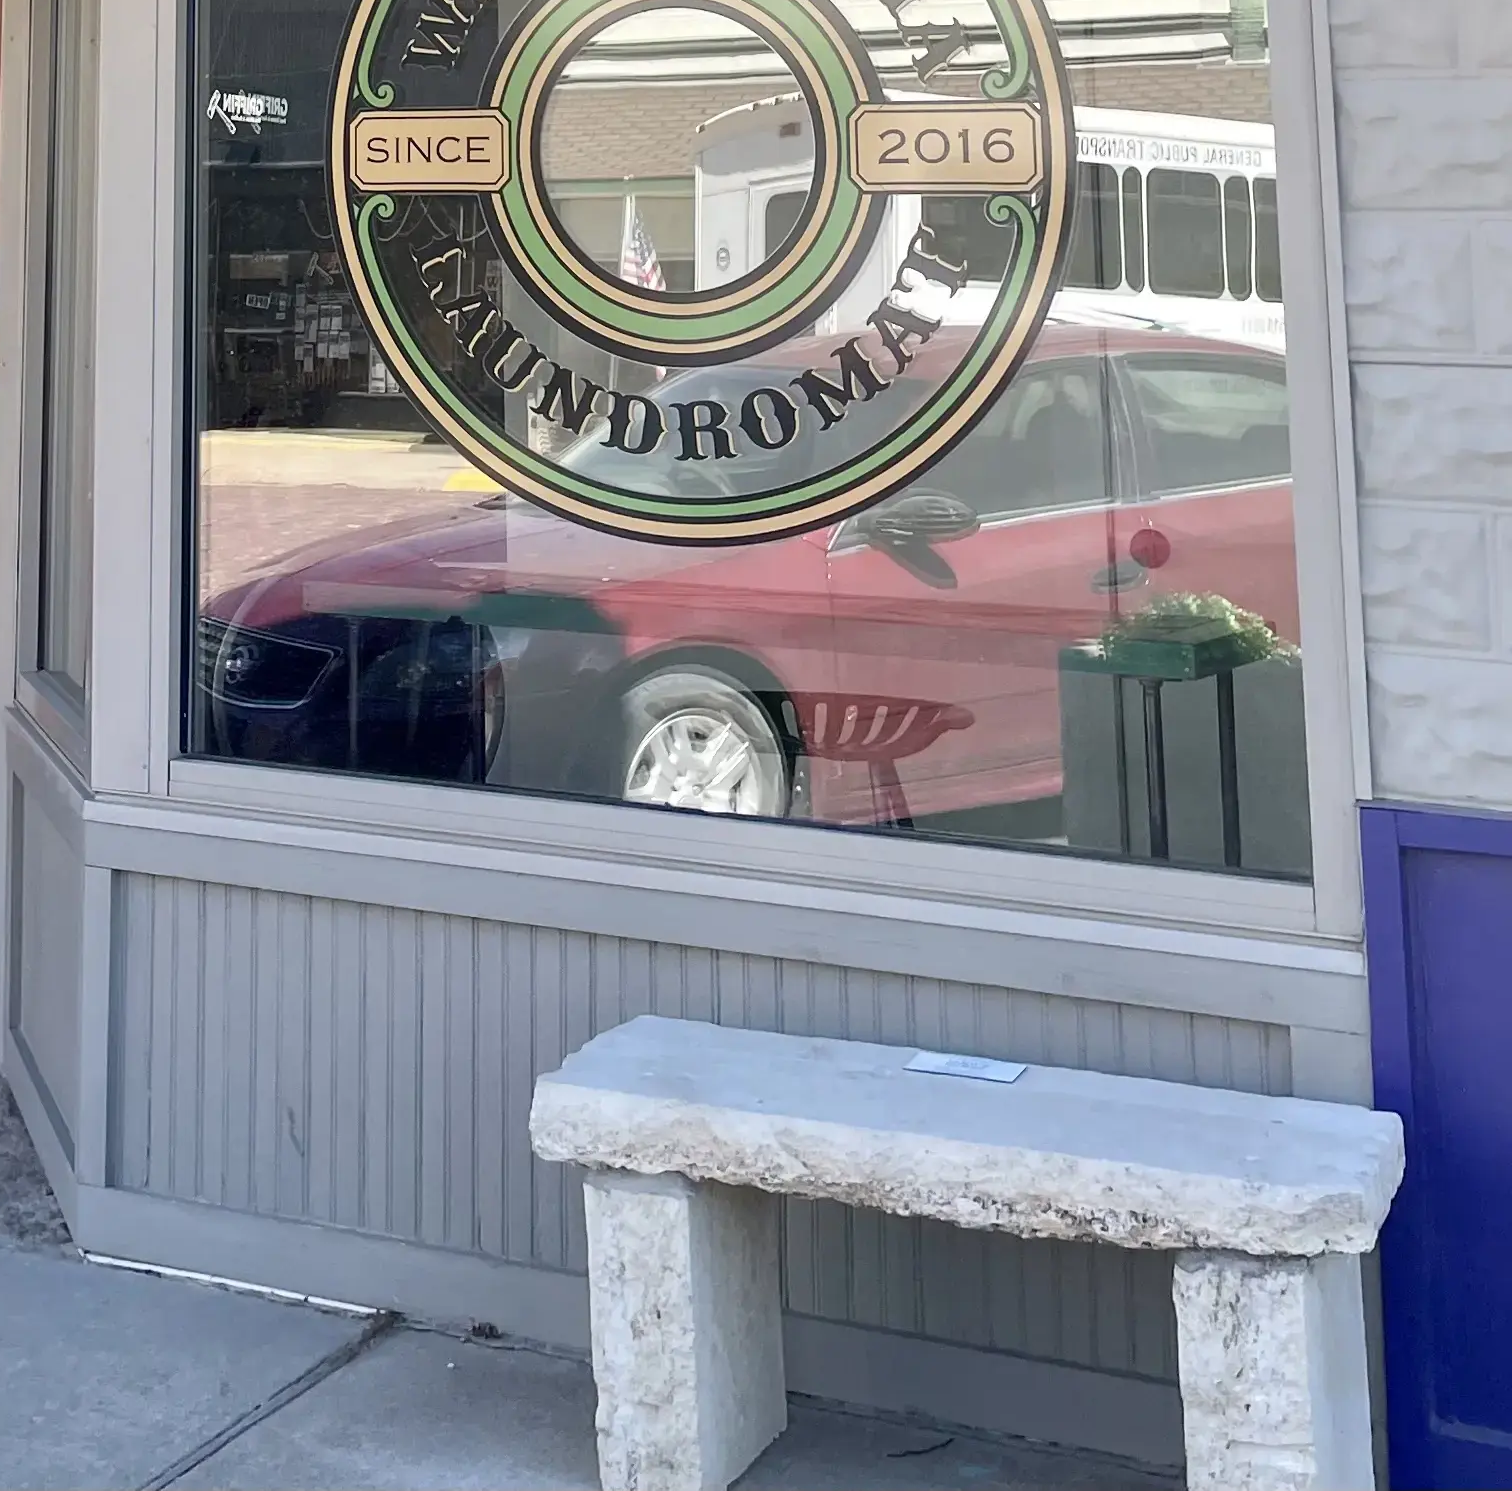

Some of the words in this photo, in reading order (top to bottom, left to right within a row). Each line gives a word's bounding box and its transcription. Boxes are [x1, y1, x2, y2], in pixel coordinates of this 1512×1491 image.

[365, 135, 491, 165] SINCE
[877, 127, 1016, 166] 2016
[409, 222, 968, 462] LAUNDROMAT
